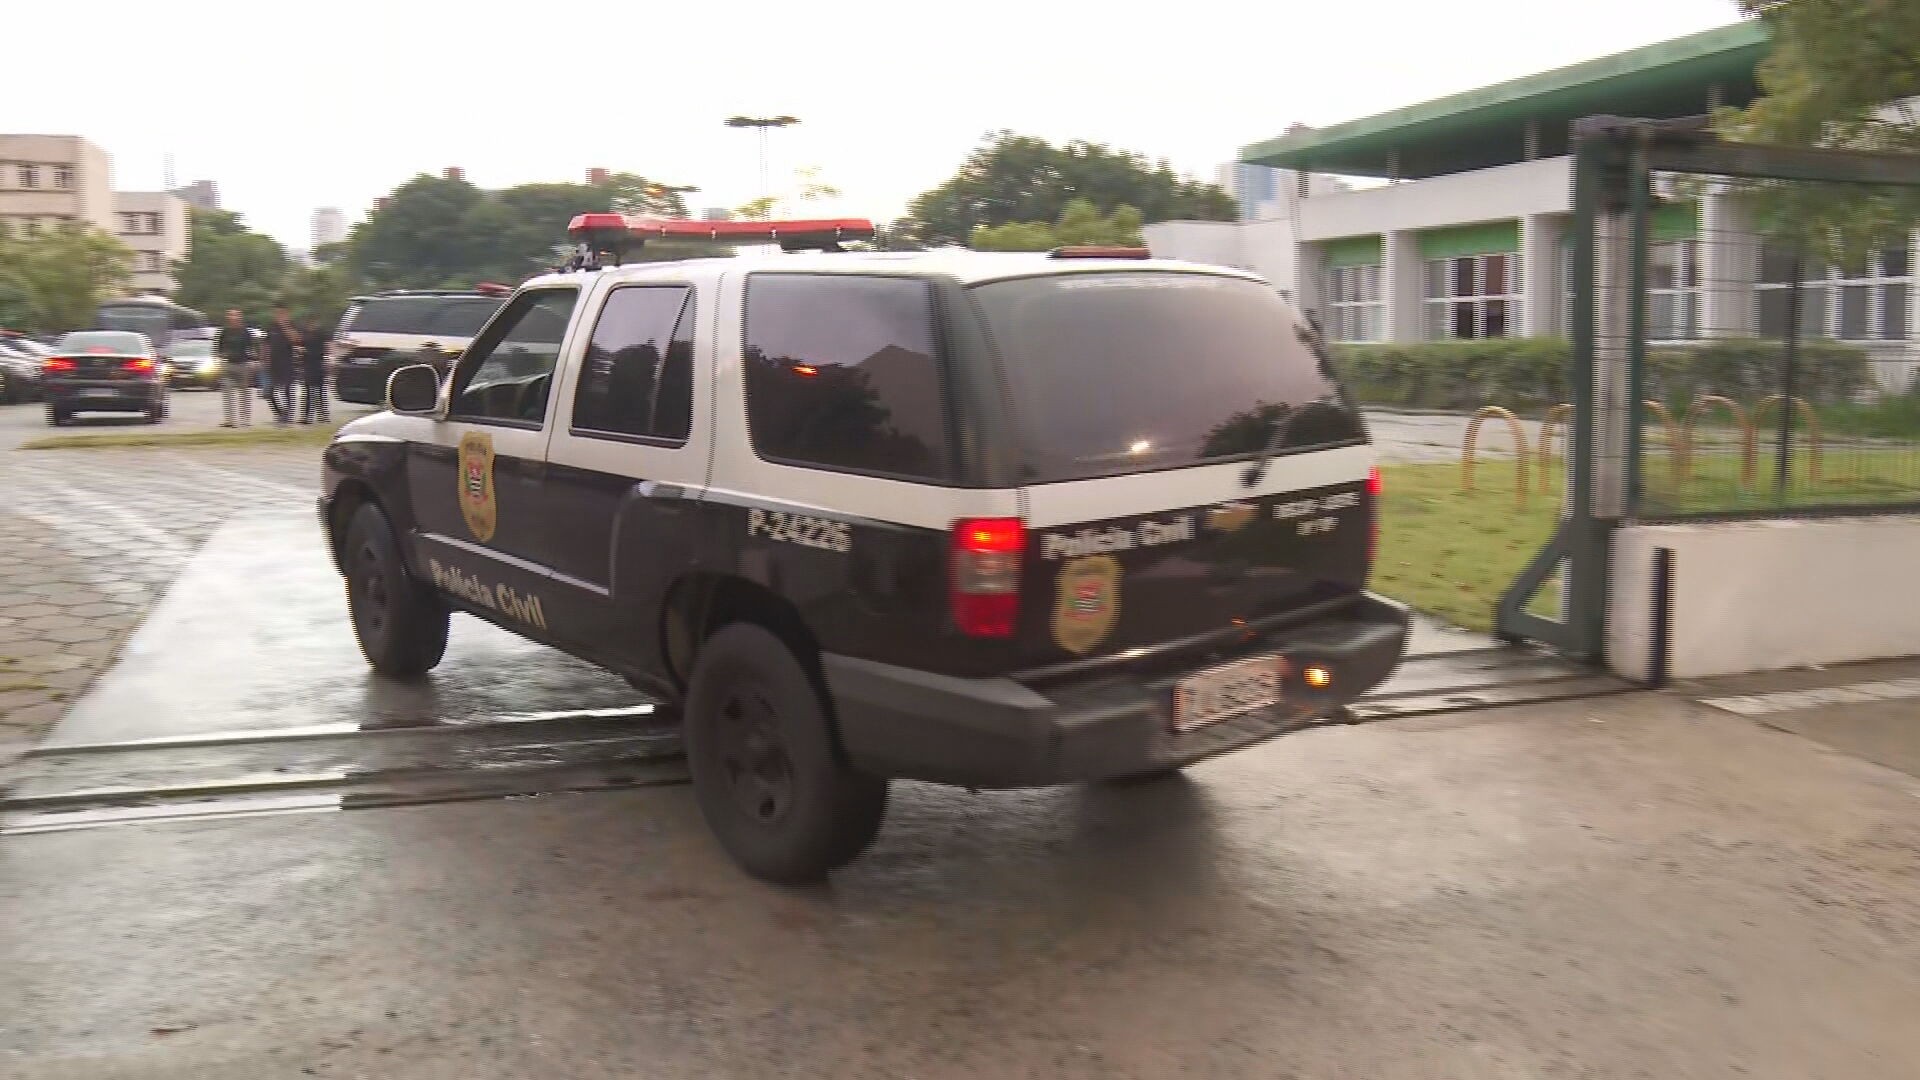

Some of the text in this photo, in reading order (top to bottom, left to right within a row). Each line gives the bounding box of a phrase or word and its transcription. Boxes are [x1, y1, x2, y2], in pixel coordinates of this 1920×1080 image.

[747, 509, 853, 553] P-24226
[1137, 515, 1195, 547] Civil
[496, 584, 548, 631] Civil
